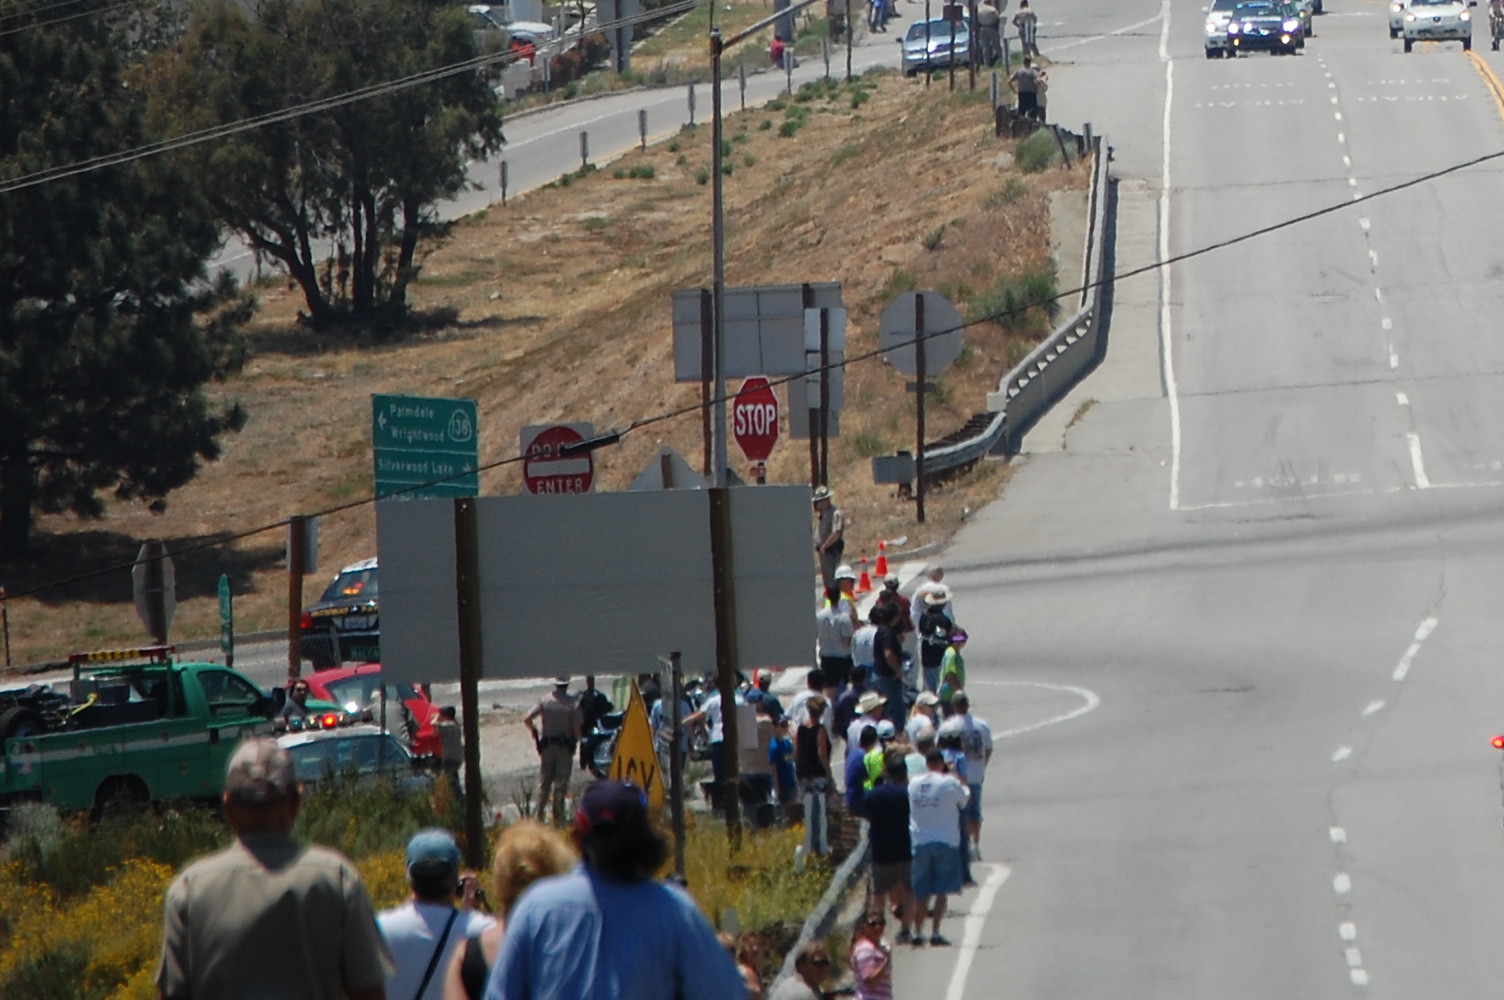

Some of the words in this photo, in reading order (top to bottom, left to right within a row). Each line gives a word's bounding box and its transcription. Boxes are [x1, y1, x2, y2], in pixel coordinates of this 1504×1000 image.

[390, 404, 434, 419] Palmdale
[736, 404, 776, 436] STOP
[391, 426, 445, 444] Wrightwood
[451, 418, 468, 437] 138
[378, 458, 428, 473] Silverwood
[432, 461, 453, 475] Lake
[536, 478, 583, 494] ENTER
